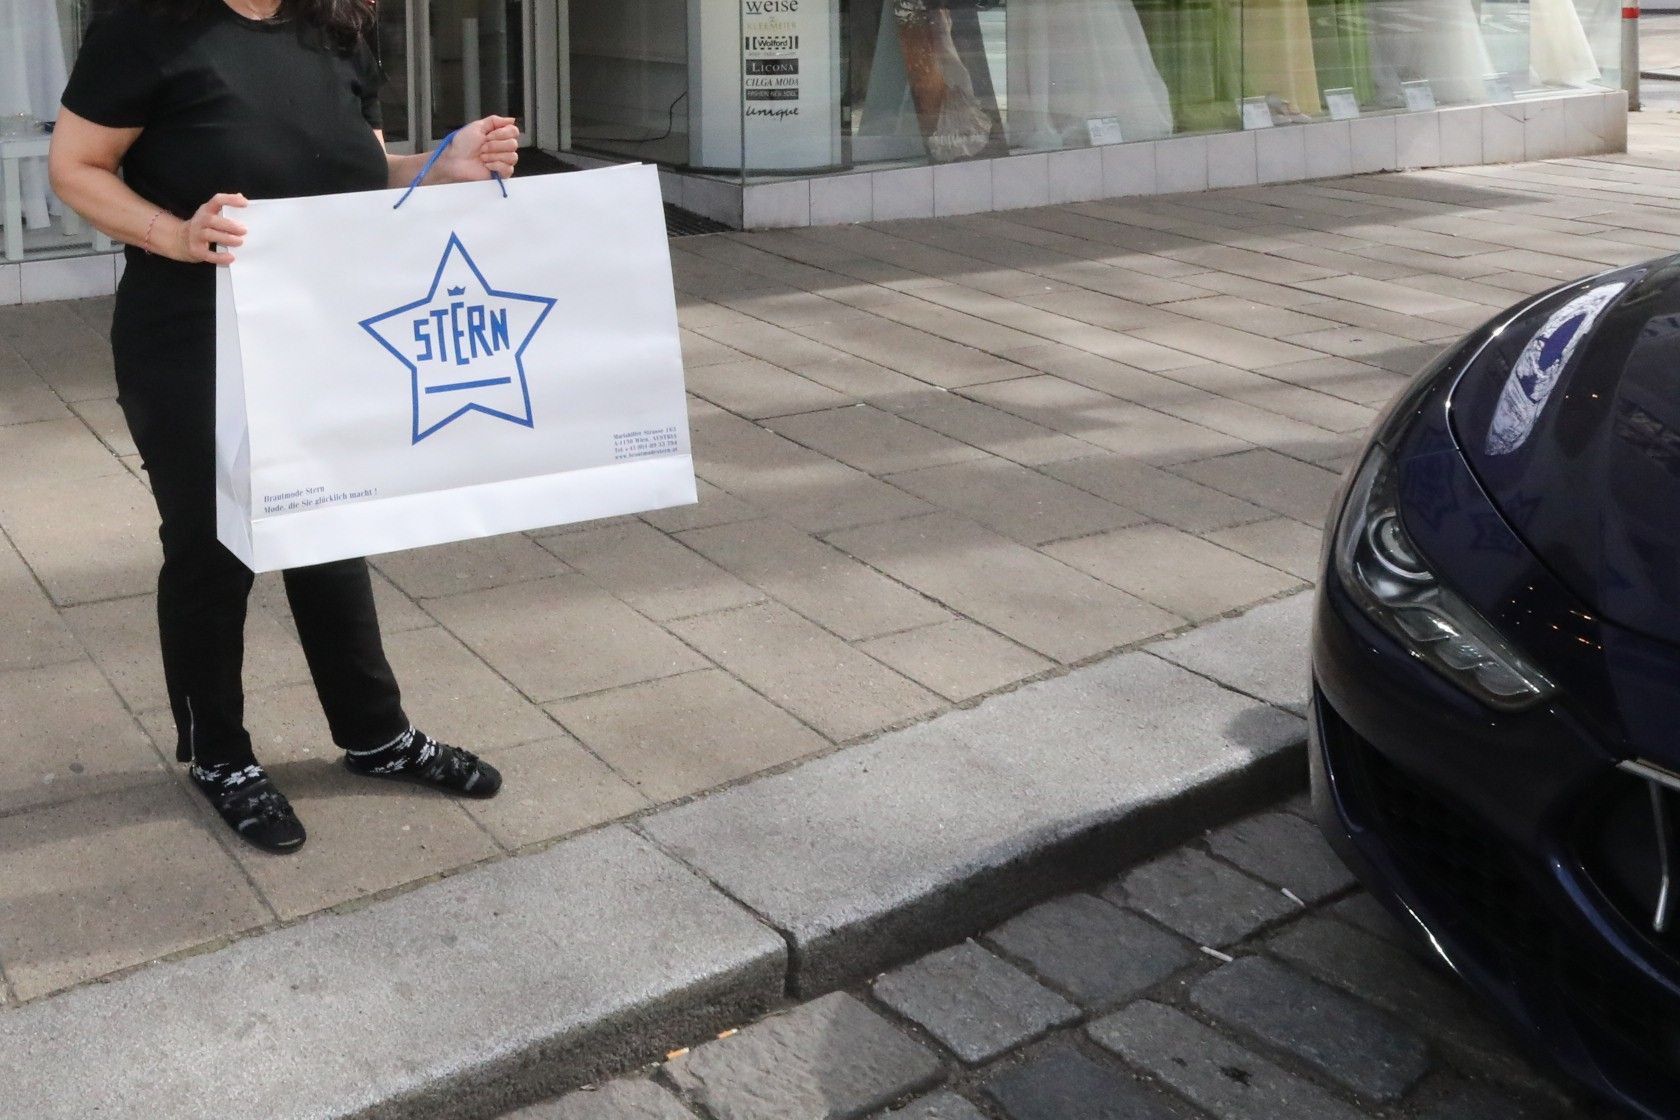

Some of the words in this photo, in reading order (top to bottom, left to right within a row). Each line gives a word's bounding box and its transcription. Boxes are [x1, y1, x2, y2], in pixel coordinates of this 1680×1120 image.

[413, 301, 510, 366] STERN
[264, 489, 303, 503] Brautmode
[305, 485, 325, 495] Stern
[288, 501, 299, 510] die
